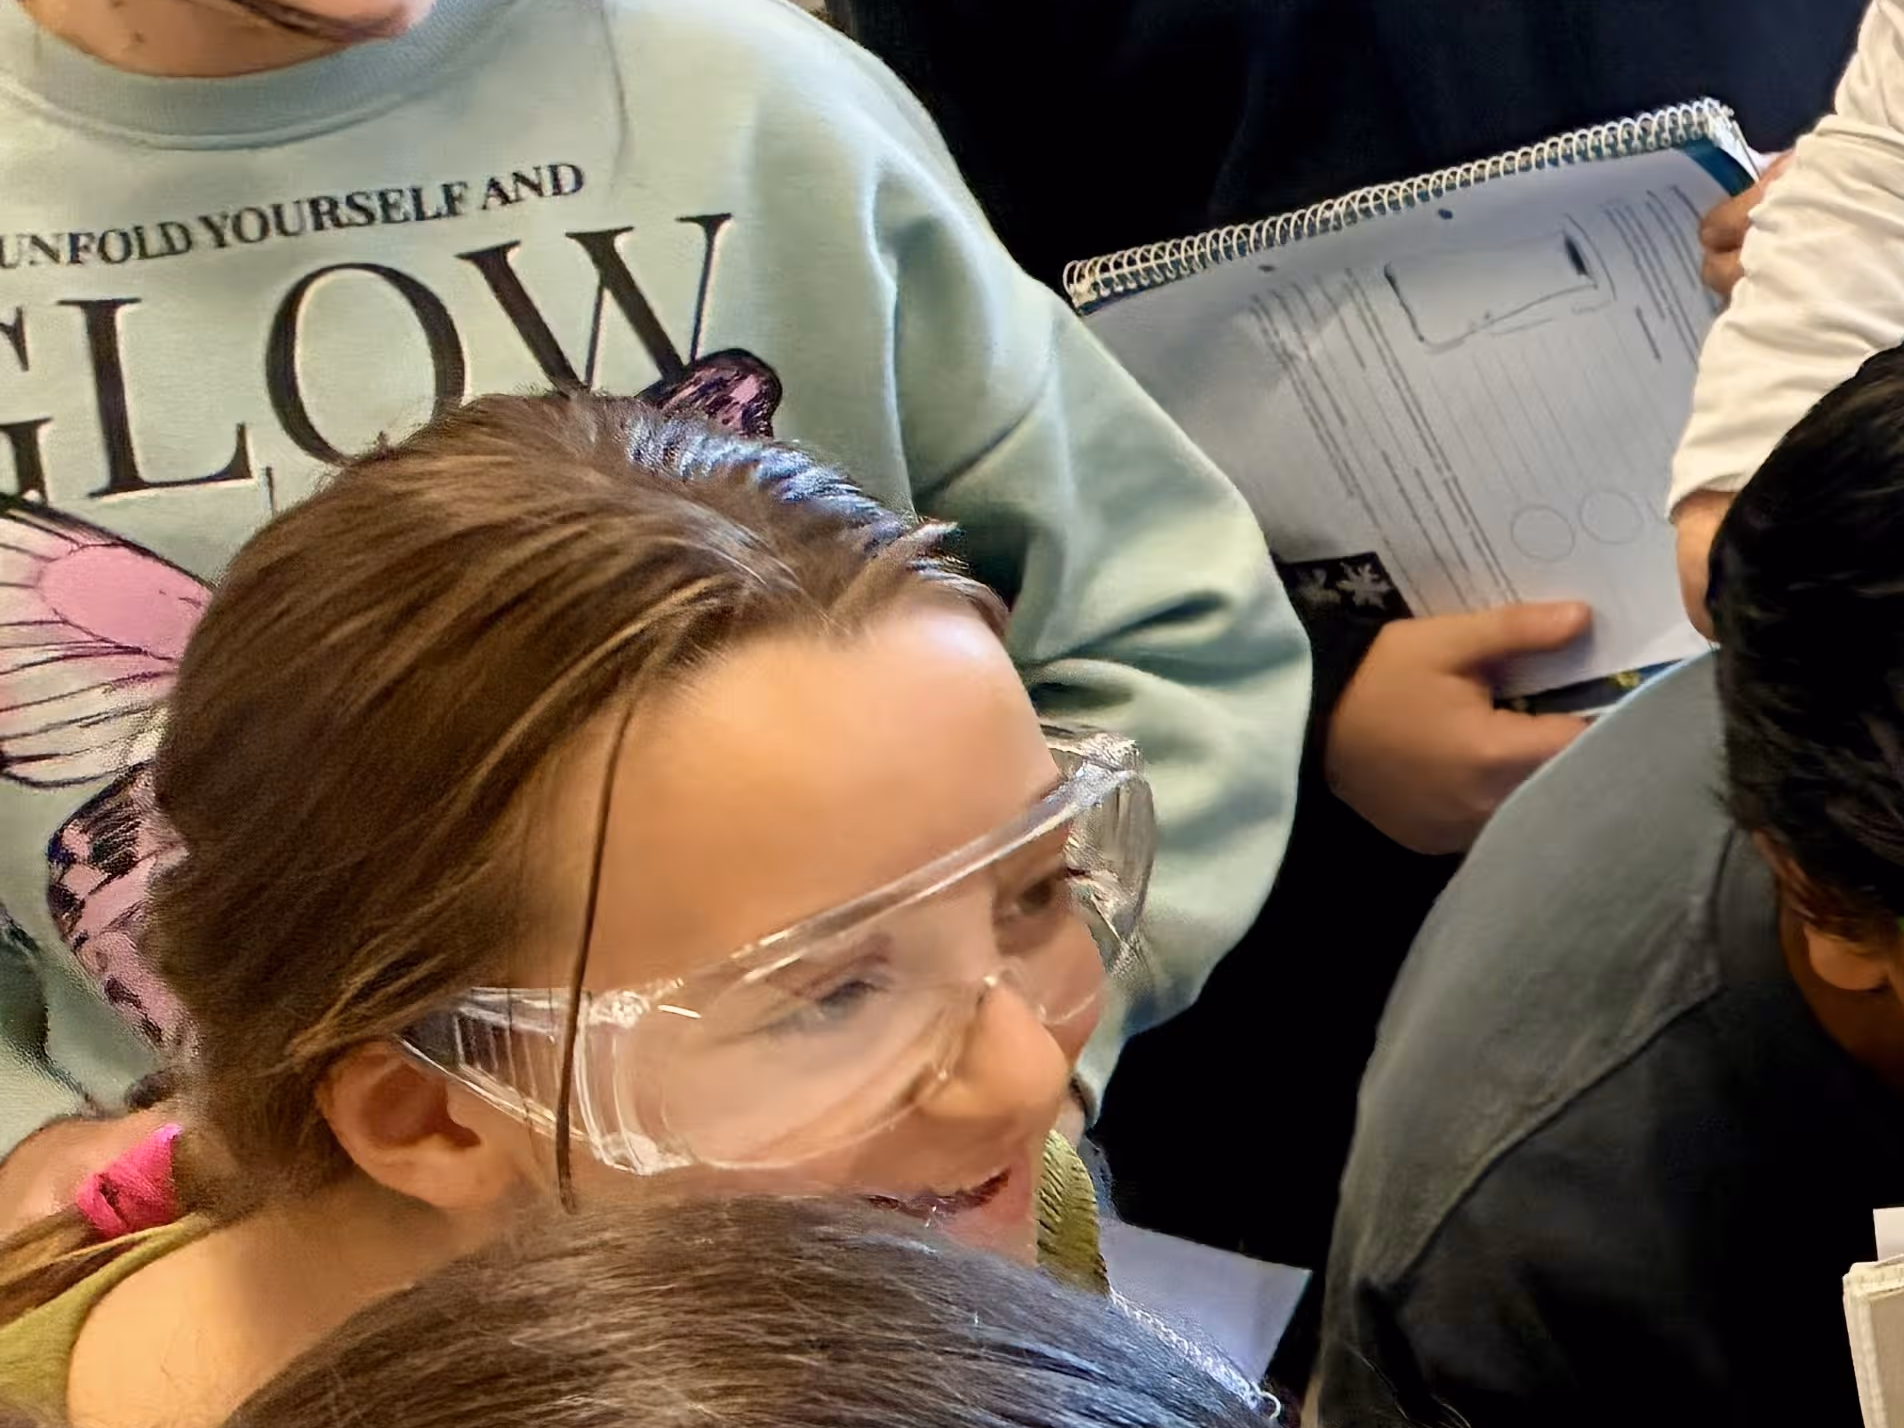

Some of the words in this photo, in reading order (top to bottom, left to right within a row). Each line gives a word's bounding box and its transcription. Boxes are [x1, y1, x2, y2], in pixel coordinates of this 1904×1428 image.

[0, 221, 193, 269] UNFOLD
[198, 180, 470, 250] YOURSELF
[481, 162, 586, 210] AND
